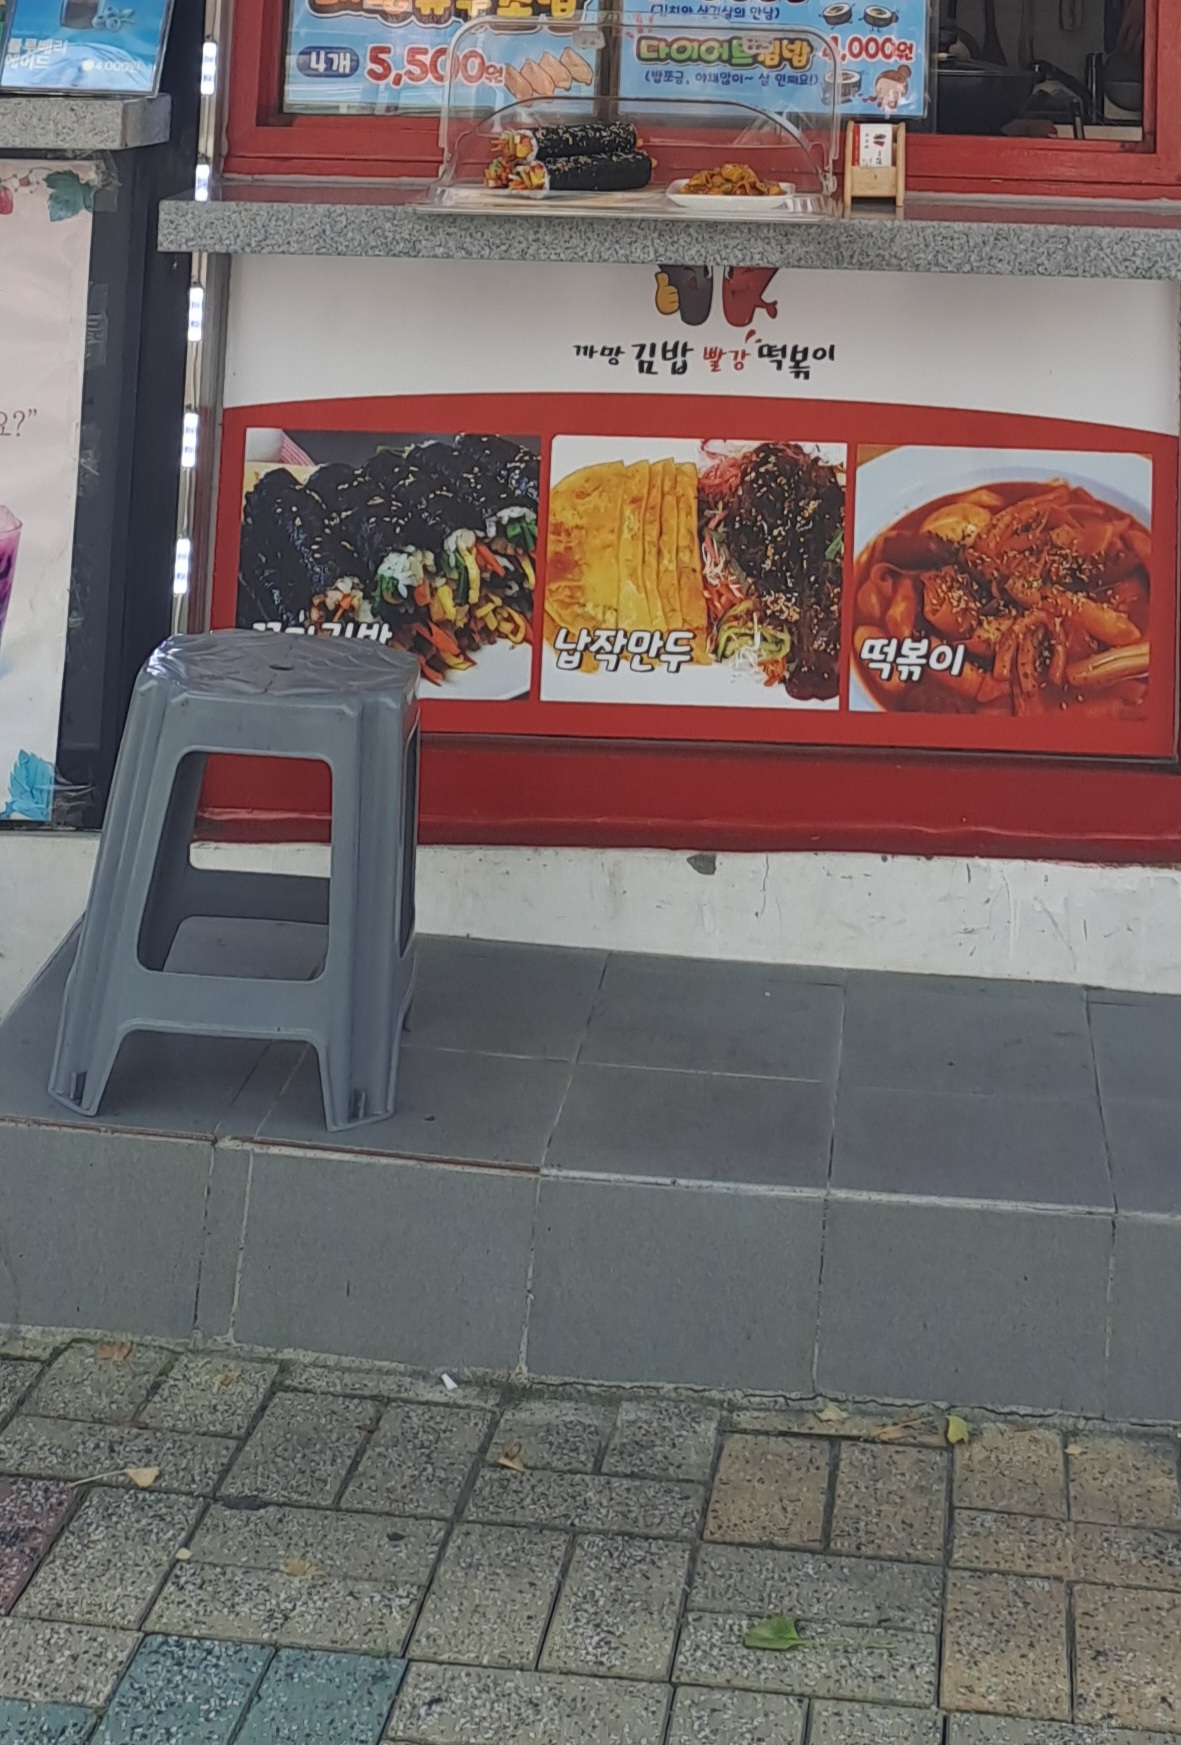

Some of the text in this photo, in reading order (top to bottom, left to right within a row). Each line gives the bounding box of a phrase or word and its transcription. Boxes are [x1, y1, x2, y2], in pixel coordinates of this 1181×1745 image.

[309, 51, 350, 72] 4개
[573, 341, 835, 380] 까망 김밥 빨강 떡볶이
[553, 628, 693, 675] 납작만두
[859, 638, 967, 680] 떡볶이
